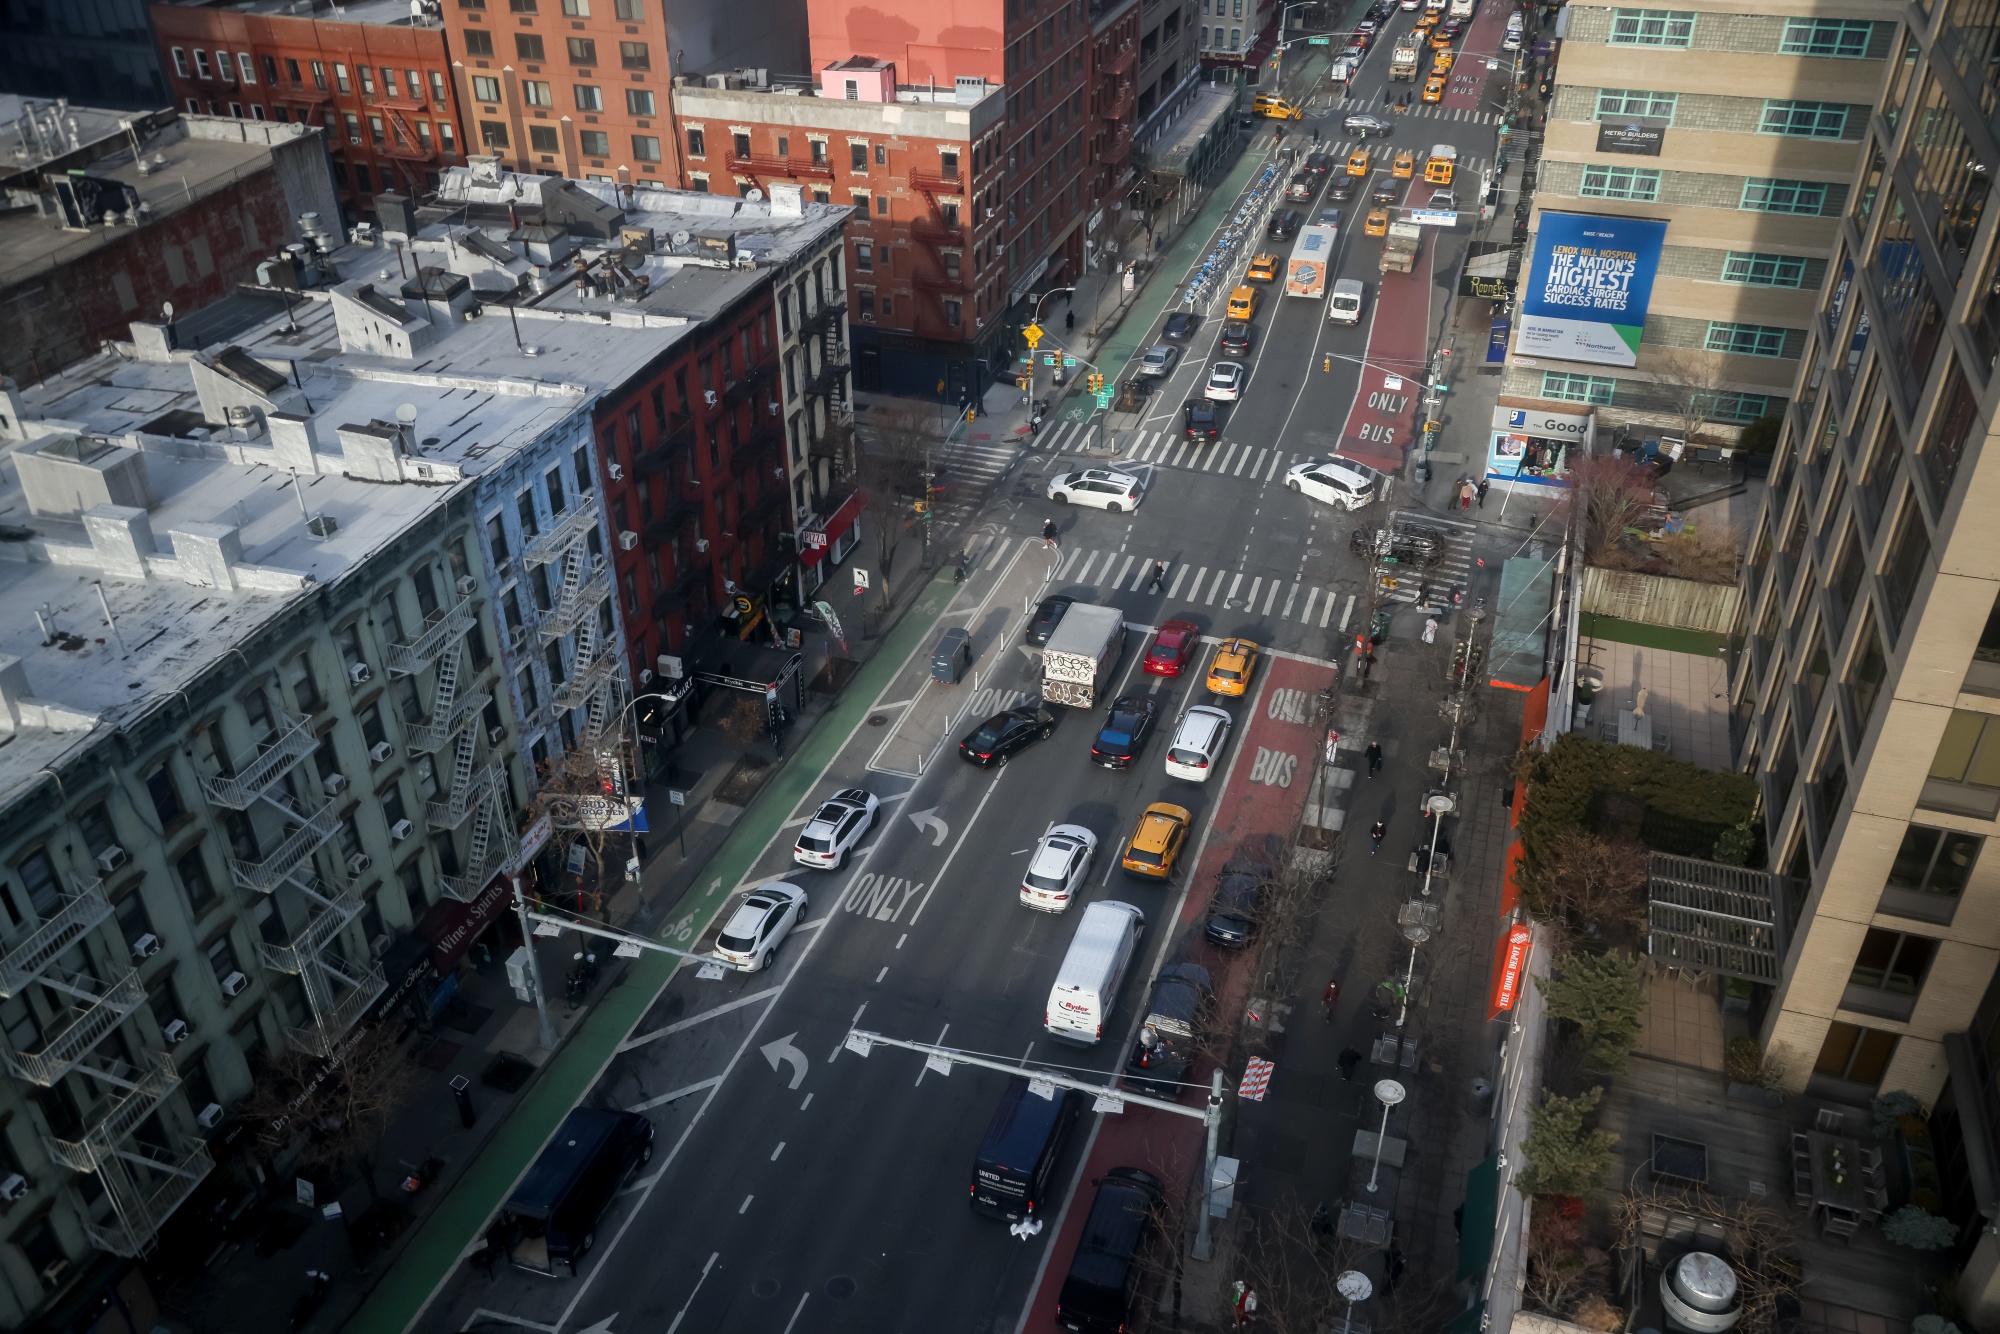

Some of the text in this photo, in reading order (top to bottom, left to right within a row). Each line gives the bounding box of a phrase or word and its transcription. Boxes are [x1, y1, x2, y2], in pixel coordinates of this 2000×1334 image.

[1456, 75, 1480, 84] ONLY
[1452, 87, 1474, 95] BUS
[1604, 129, 1658, 139] METRO BUILDERS
[1553, 245, 1637, 260] LENOX HILL HOSPITAL
[1551, 253, 1636, 273] THE NATION'S
[1547, 265, 1634, 291] HIGHEST
[1545, 284, 1629, 300] CARDIAC SURGERY
[1543, 293, 1628, 311] SUCCESS RATES
[1586, 342, 1616, 351] Northwell
[1368, 391, 1408, 413] ONLY
[1359, 423, 1395, 444] BUS
[1544, 419, 1588, 434] Good
[805, 532, 825, 544] PIZZA
[724, 678, 744, 687] Psychic
[1249, 745, 1298, 788] BUS
[845, 872, 924, 922] ONLY
[437, 884, 503, 954] Wine & Spirits
[1500, 945, 1521, 1007] THE HOME DEPOT
[378, 985, 405, 1018] MANNY'S
[1065, 1002, 1089, 1012] Ryder
[271, 1112, 291, 1131] Dry
[315, 1072, 325, 1082] &
[978, 1169, 1000, 1181] UNITED
